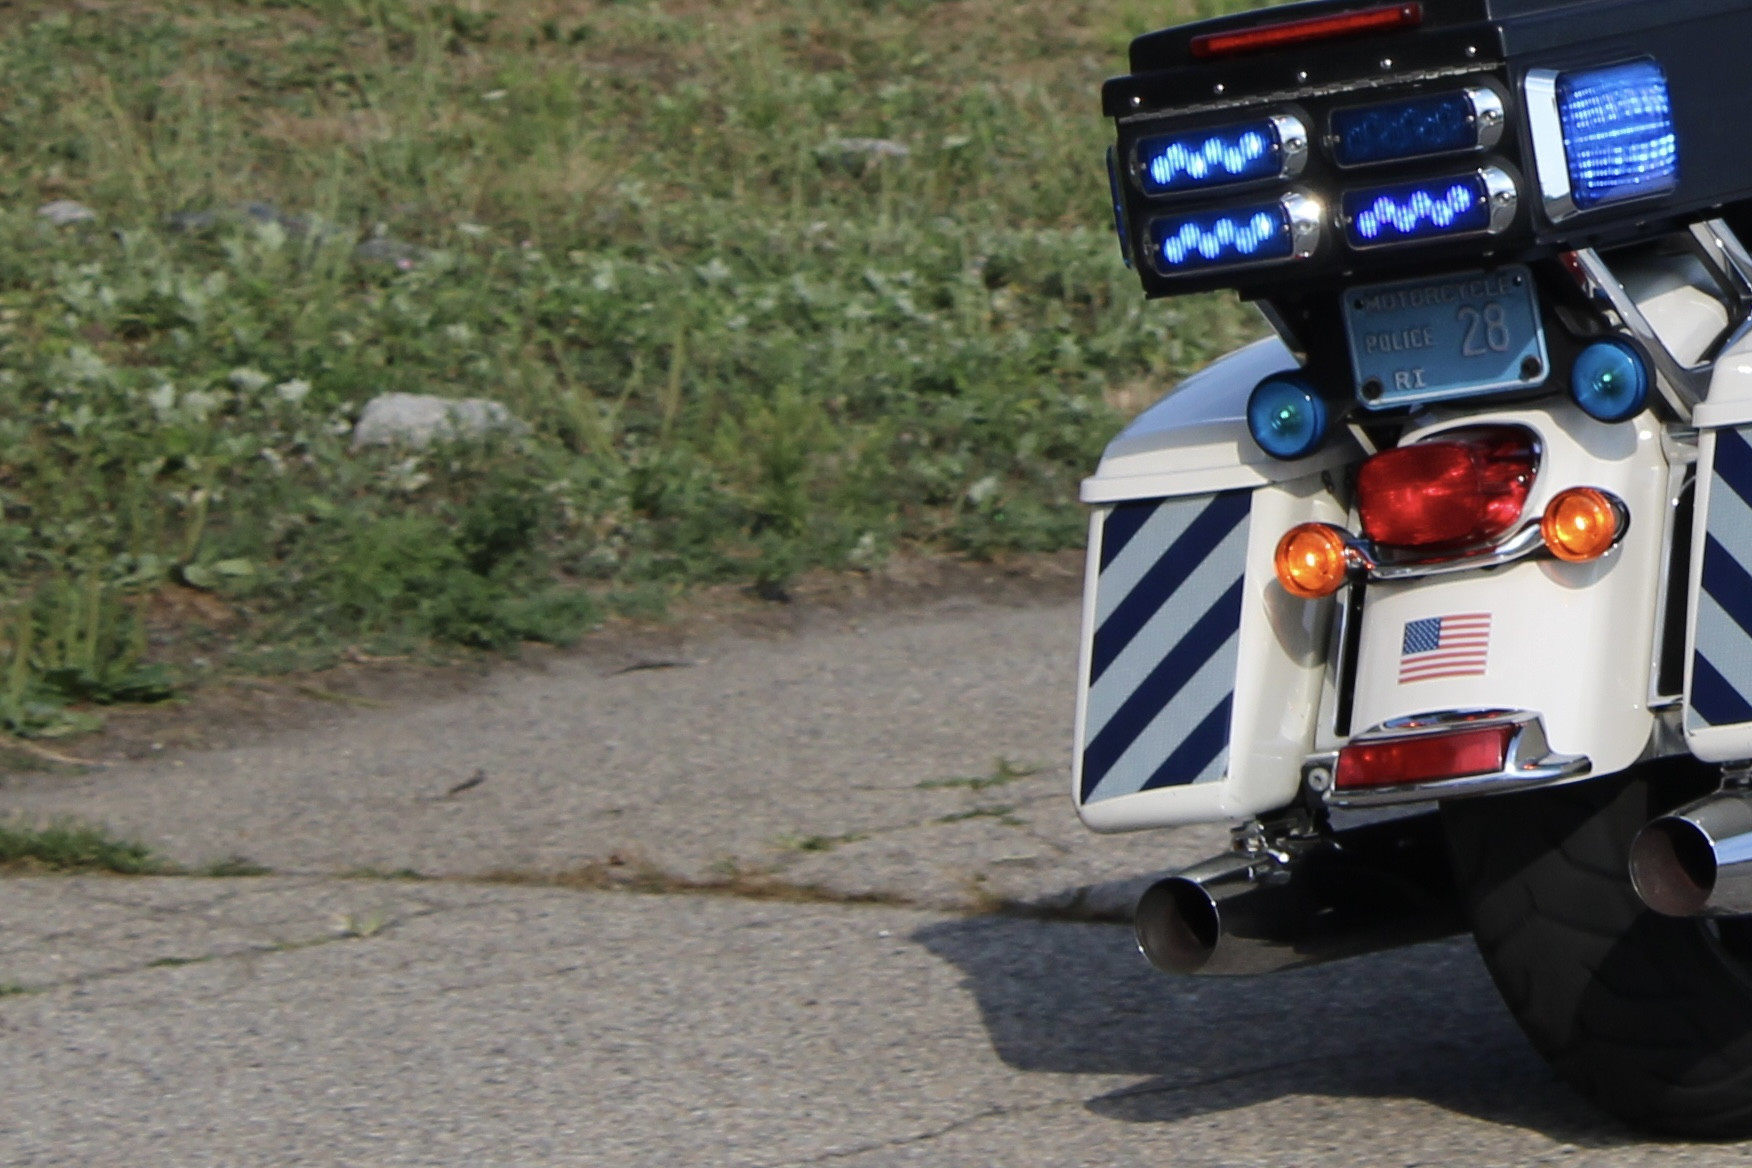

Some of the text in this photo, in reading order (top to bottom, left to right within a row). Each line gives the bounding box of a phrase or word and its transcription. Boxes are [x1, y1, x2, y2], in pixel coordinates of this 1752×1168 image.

[1364, 275, 1512, 312] MOTORCYCLE
[1365, 326, 1434, 354] POLICE
[1458, 302, 1510, 357] 28
[1394, 367, 1427, 390] RI
